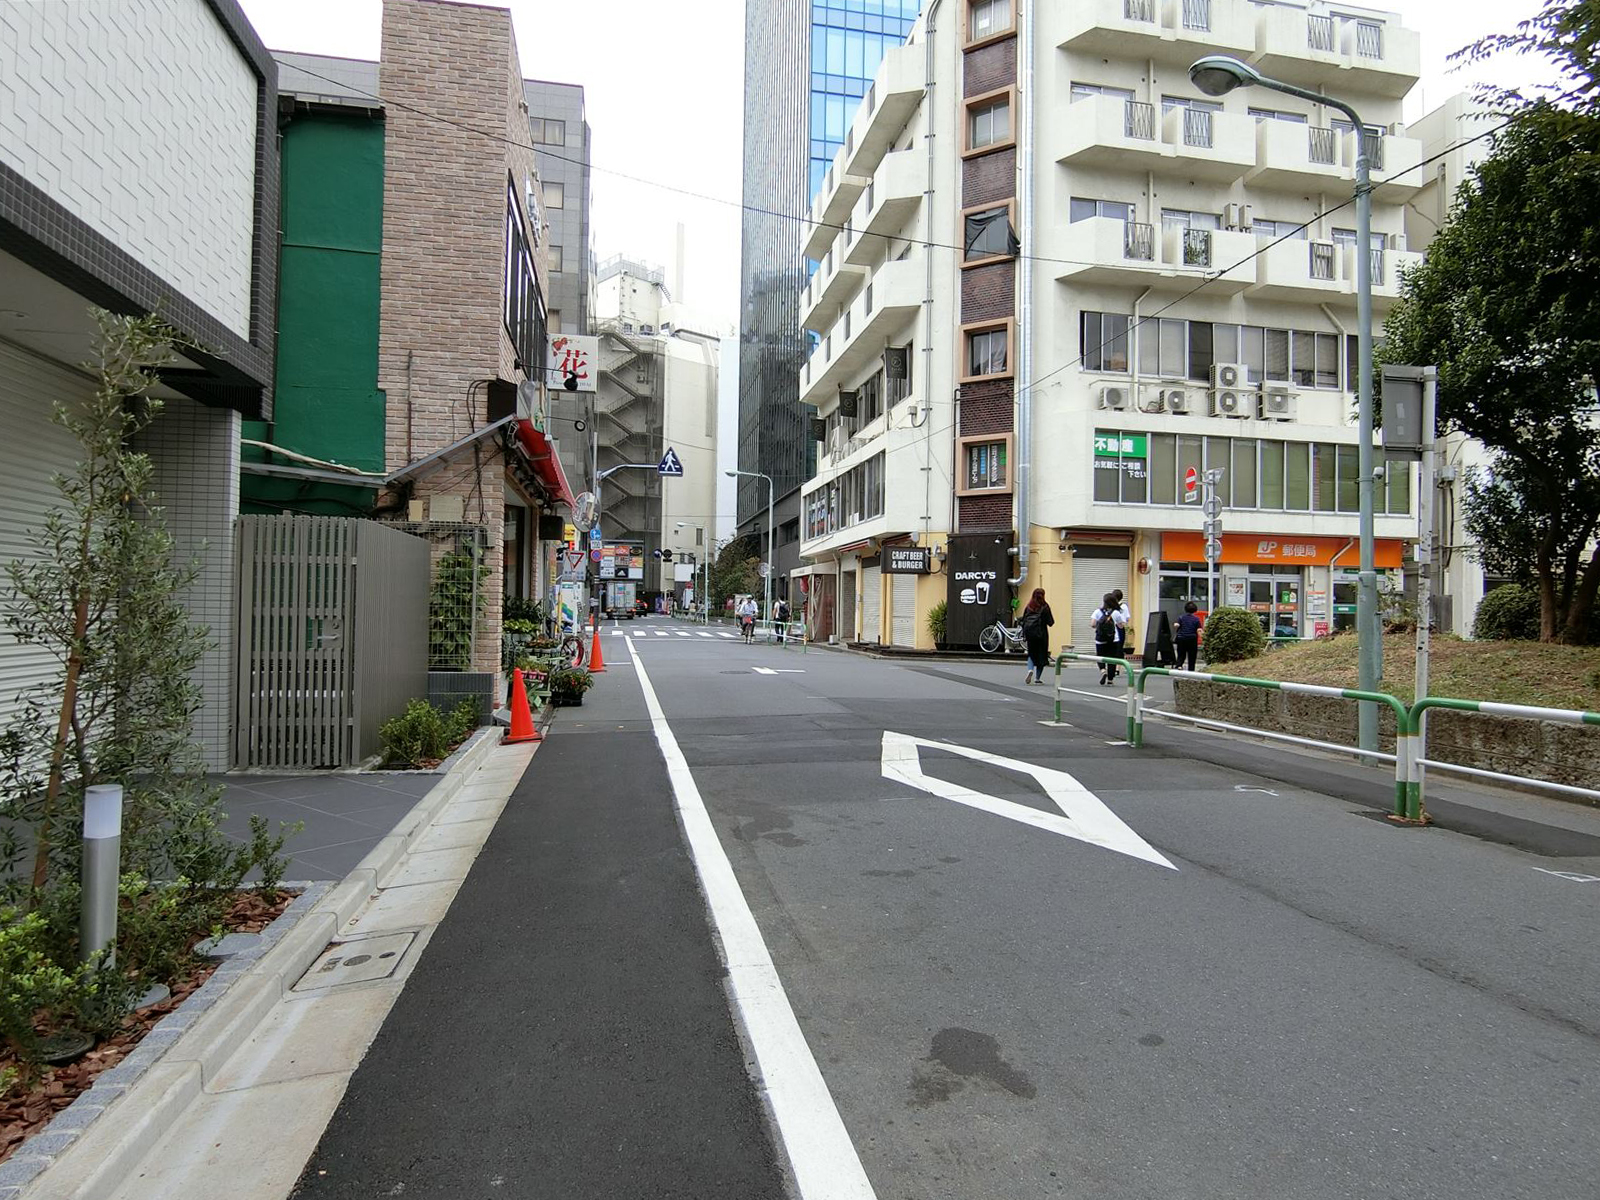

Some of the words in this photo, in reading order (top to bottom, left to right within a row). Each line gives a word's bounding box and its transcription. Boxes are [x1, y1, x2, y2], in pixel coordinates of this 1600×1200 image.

[558, 349, 589, 379] 花
[1094, 437, 1134, 453] 不動産
[1127, 470, 1147, 478] 下さい
[891, 550, 910, 560] CRAFT
[909, 550, 924, 560] BEER
[1282, 544, 1317, 558] 郵便局
[891, 560, 898, 569] &
[897, 560, 924, 569] BURGER
[955, 571, 997, 580] DARCY'S
